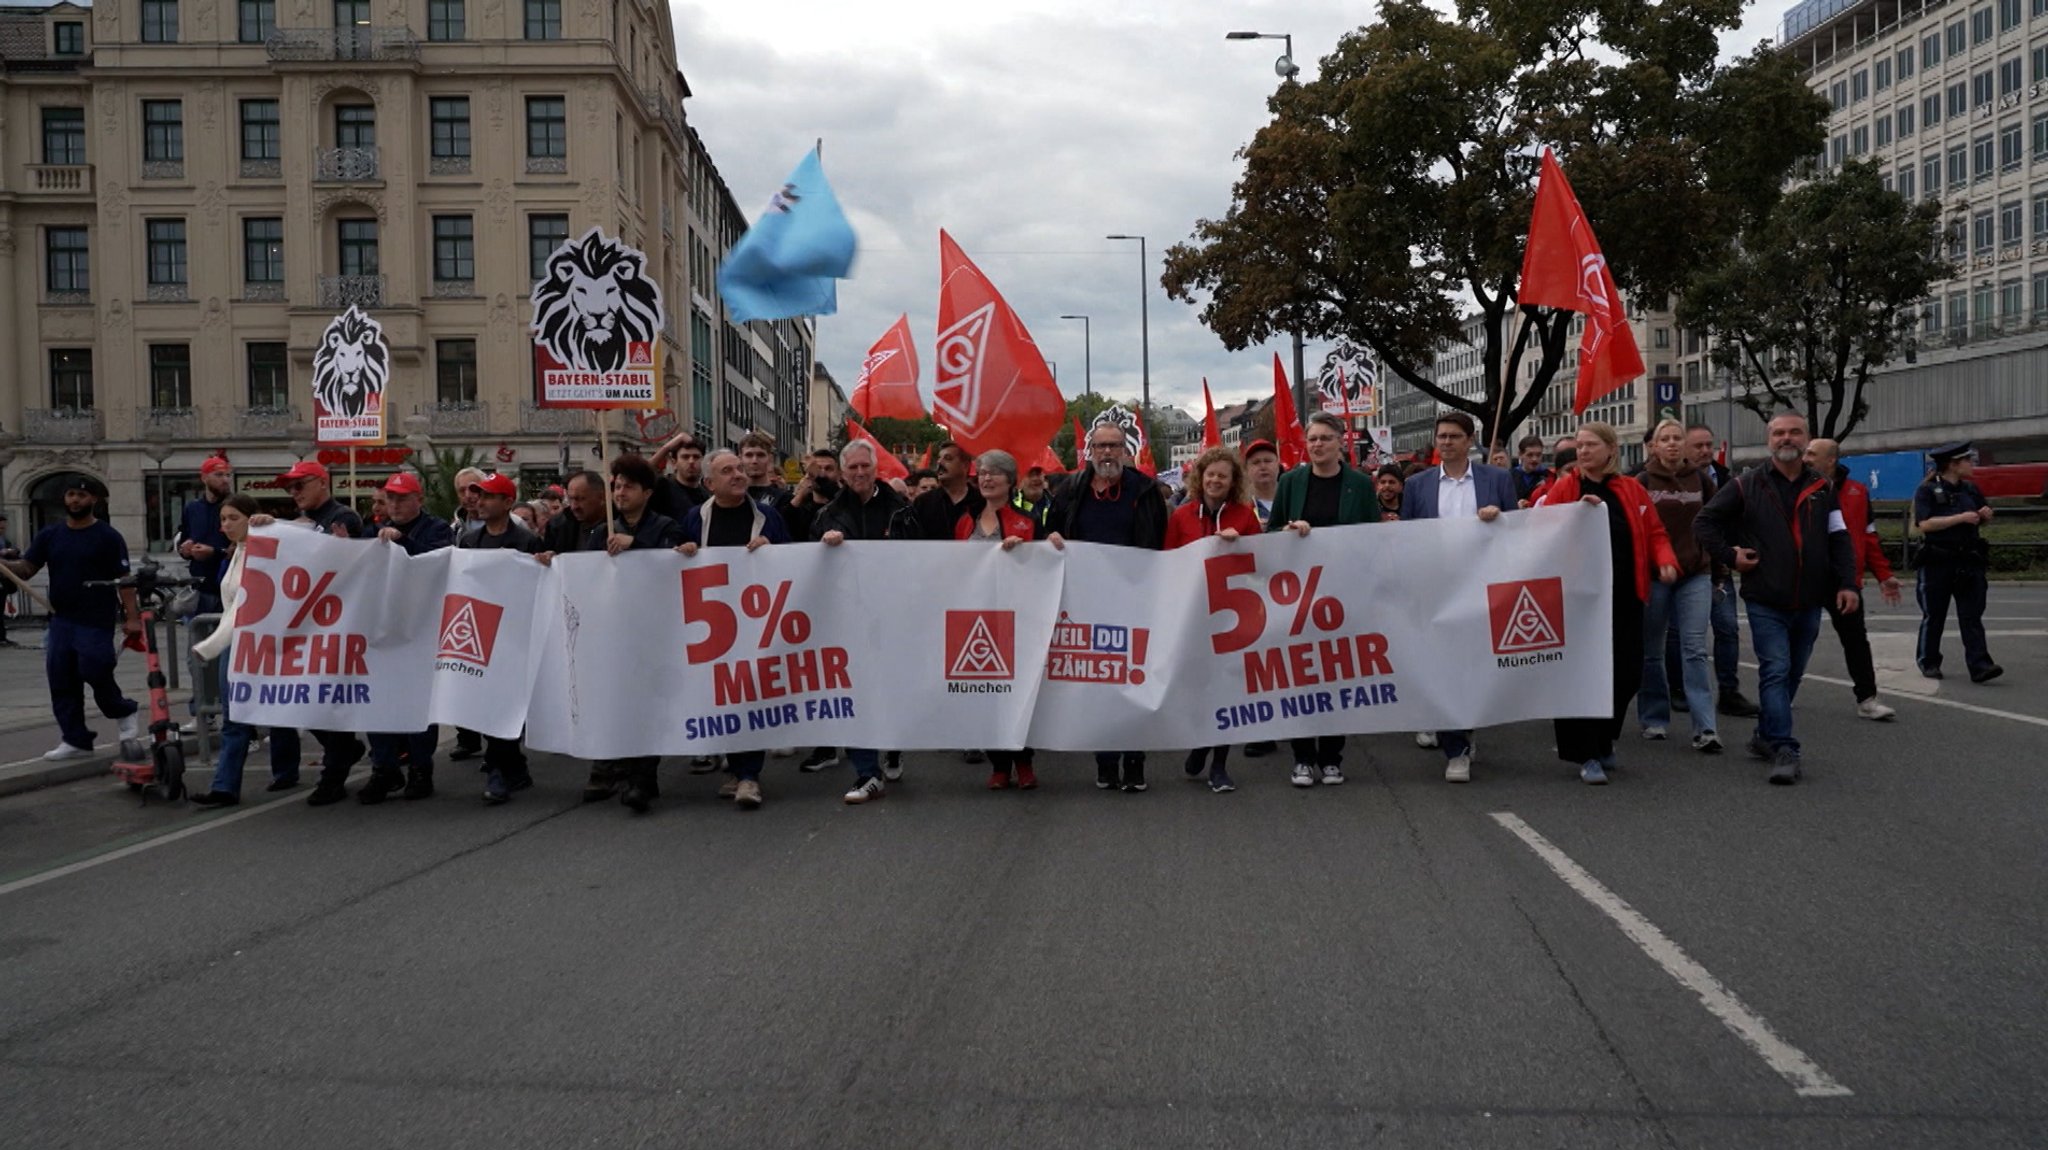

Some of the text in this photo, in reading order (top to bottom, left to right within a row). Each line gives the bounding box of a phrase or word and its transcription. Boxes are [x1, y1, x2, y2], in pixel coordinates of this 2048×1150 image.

[622, 389, 652, 398] ALLES
[1660, 384, 1673, 401] U
[681, 563, 811, 665] 5%
[1204, 552, 1345, 655] 5%
[233, 631, 369, 676] MEHR
[1097, 628, 1124, 648] DU
[1497, 651, 1563, 668] München
[714, 647, 852, 706] MEHR
[1243, 633, 1394, 694] MEHR
[259, 683, 310, 704] NUR
[318, 683, 371, 704] FAIR
[948, 681, 1012, 694] München
[1215, 683, 1398, 730] SIND NUR FAIR
[685, 697, 855, 740] SIND NUR FAIR
